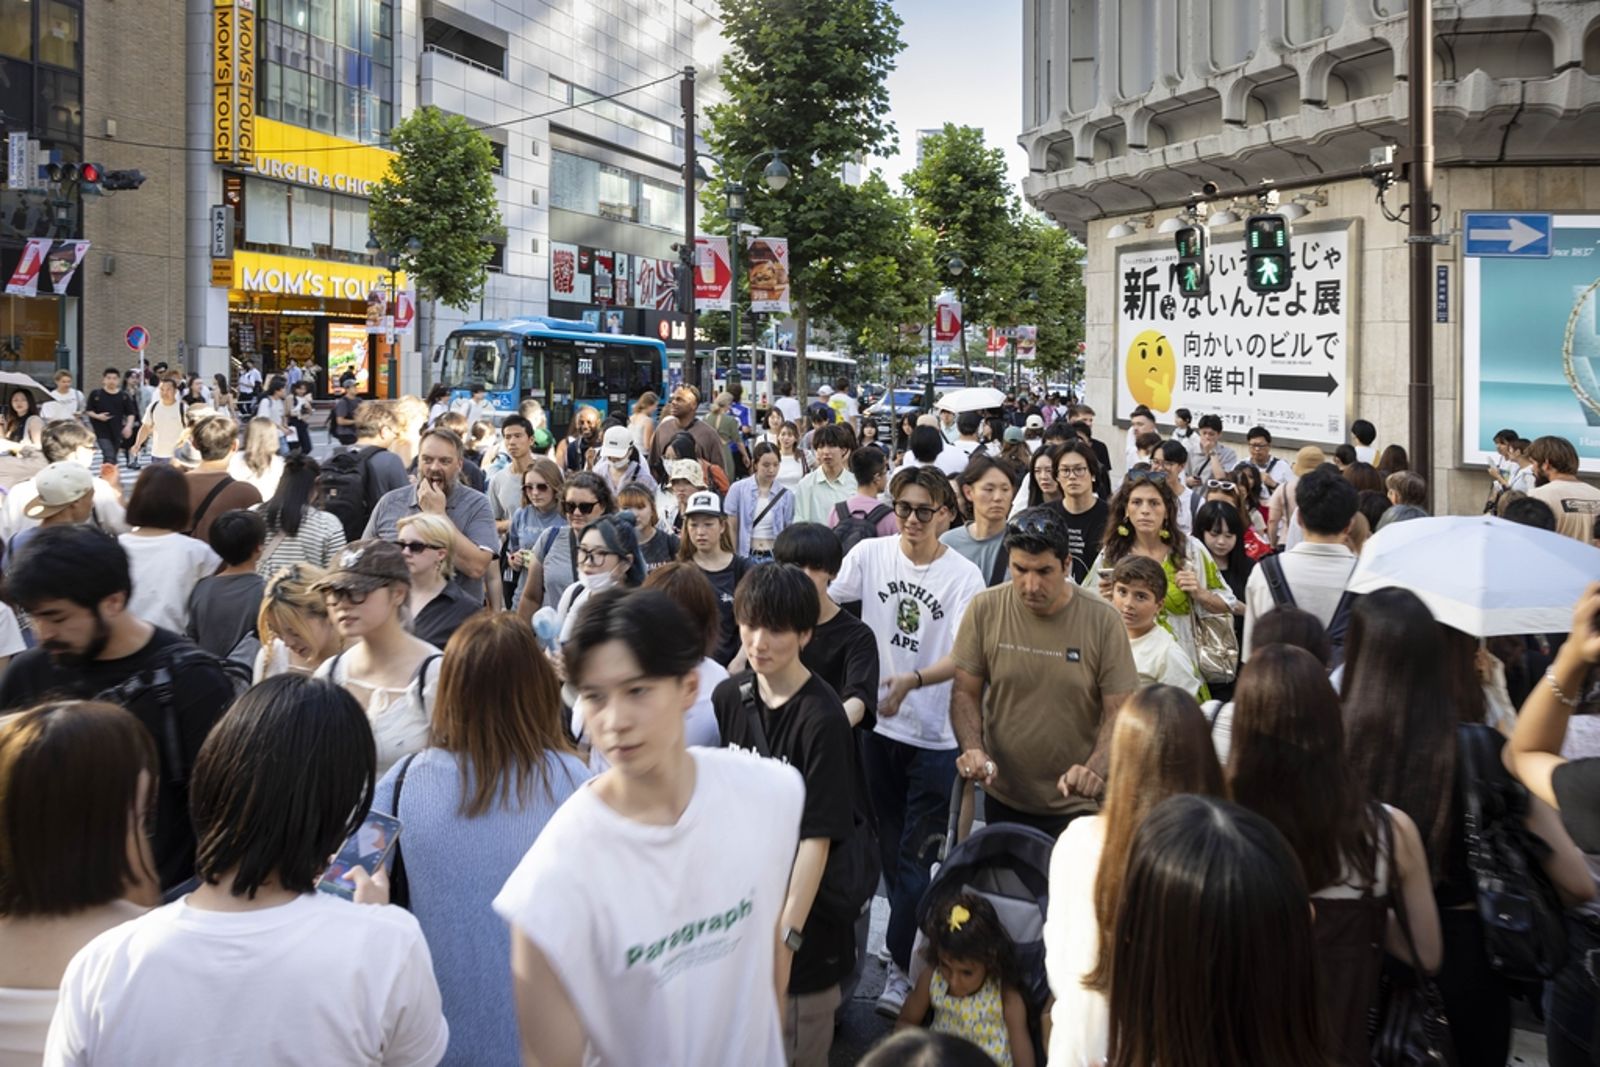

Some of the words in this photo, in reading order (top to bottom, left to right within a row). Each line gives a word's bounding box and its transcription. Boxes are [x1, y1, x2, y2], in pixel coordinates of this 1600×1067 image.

[217, 11, 232, 81] MOM'S
[239, 13, 253, 84] MOM'S
[217, 87, 230, 161] TOUCH
[239, 86, 251, 163] TOUCH
[244, 156, 320, 187] URGER
[322, 175, 331, 188] &
[242, 266, 323, 298] MOM'S
[1183, 331, 1340, 361] 向かいのビルで
[1183, 365, 1254, 398] 開催中!
[878, 591, 889, 603] A
[887, 581, 944, 621] BATHING
[890, 633, 920, 653] APE
[626, 898, 753, 970] Paragraph
